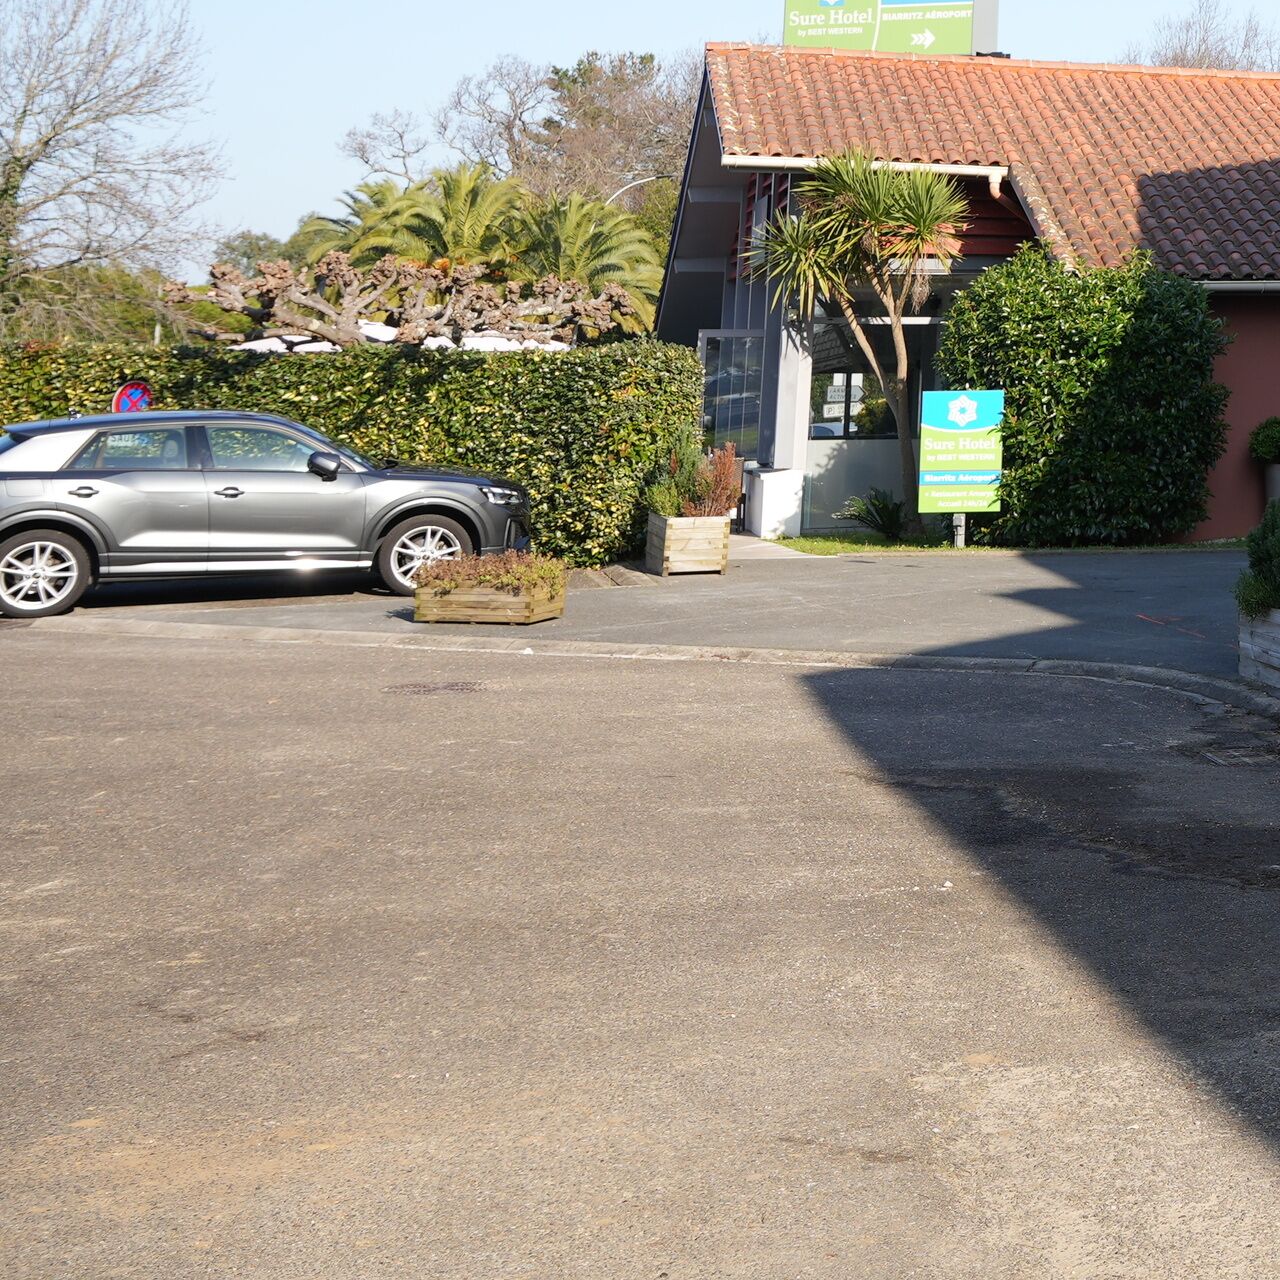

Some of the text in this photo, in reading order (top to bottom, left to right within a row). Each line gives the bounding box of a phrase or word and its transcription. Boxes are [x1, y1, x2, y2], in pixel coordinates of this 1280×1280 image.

[789, 8, 873, 26] Sure Hotel
[882, 9, 973, 20] BIARRITZ AÉROPORT
[798, 27, 863, 38] by BEST WESTERN
[924, 437, 995, 450] Sure Hotel
[924, 474, 956, 482] Biarritz
